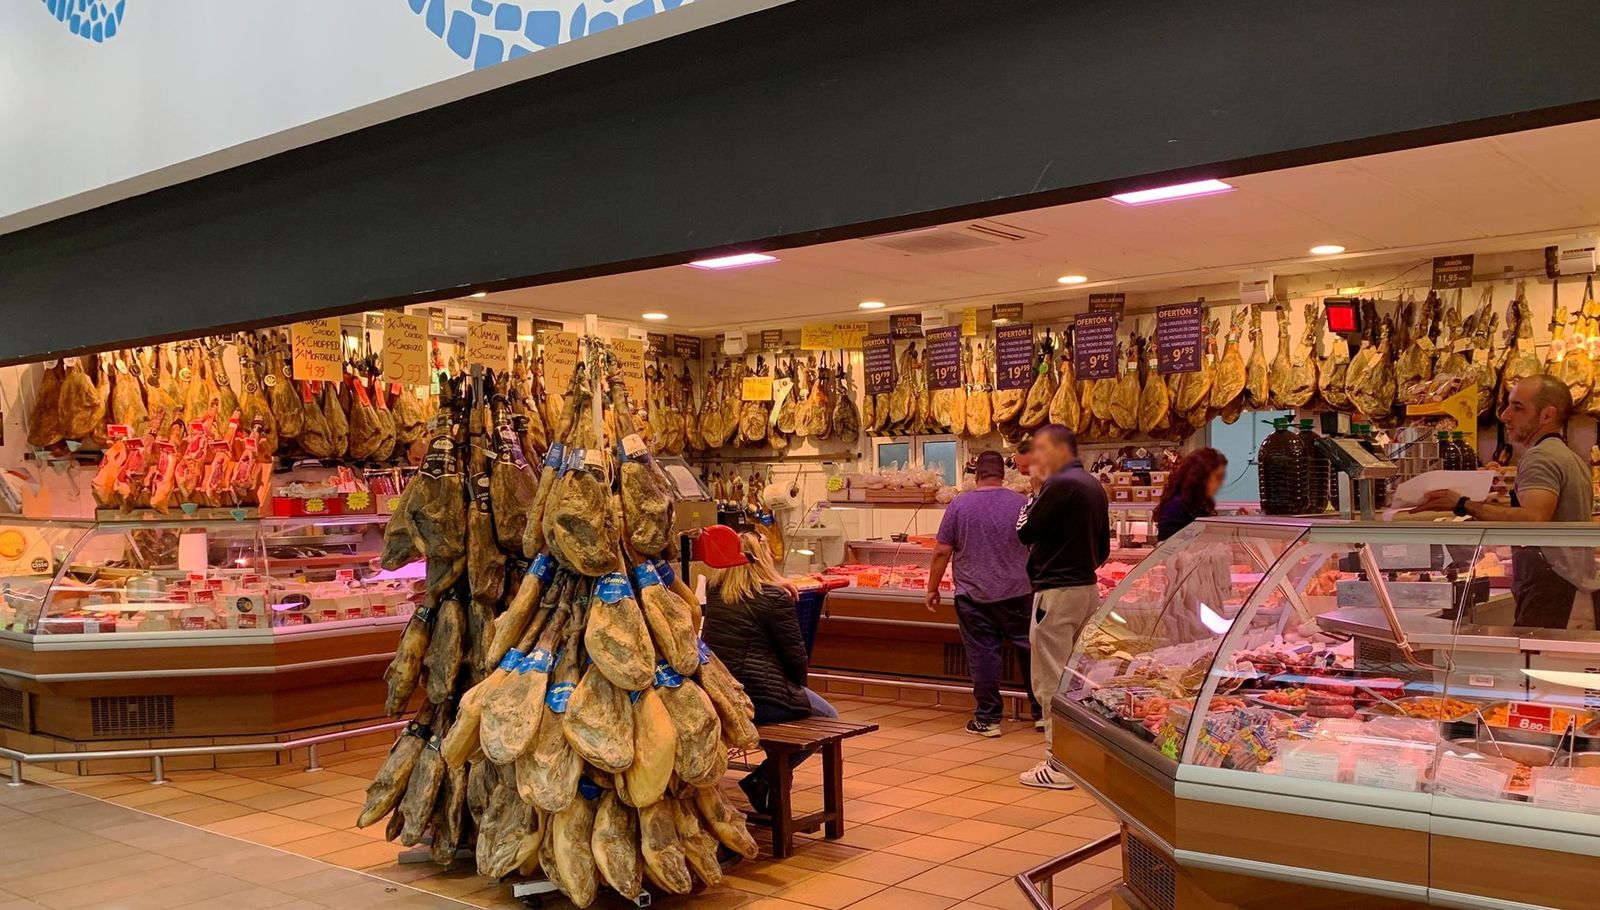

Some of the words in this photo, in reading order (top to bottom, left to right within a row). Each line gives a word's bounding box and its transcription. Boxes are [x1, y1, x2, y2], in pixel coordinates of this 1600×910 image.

[1158, 308, 1191, 318] OFERTÓN
[1077, 317, 1107, 326] OFERTÓN
[927, 332, 951, 340] OFERTÓN
[999, 330, 1027, 338] OFERTÓN
[306, 336, 340, 350] CHOPPED
[864, 338, 885, 347] OFERTÓN
